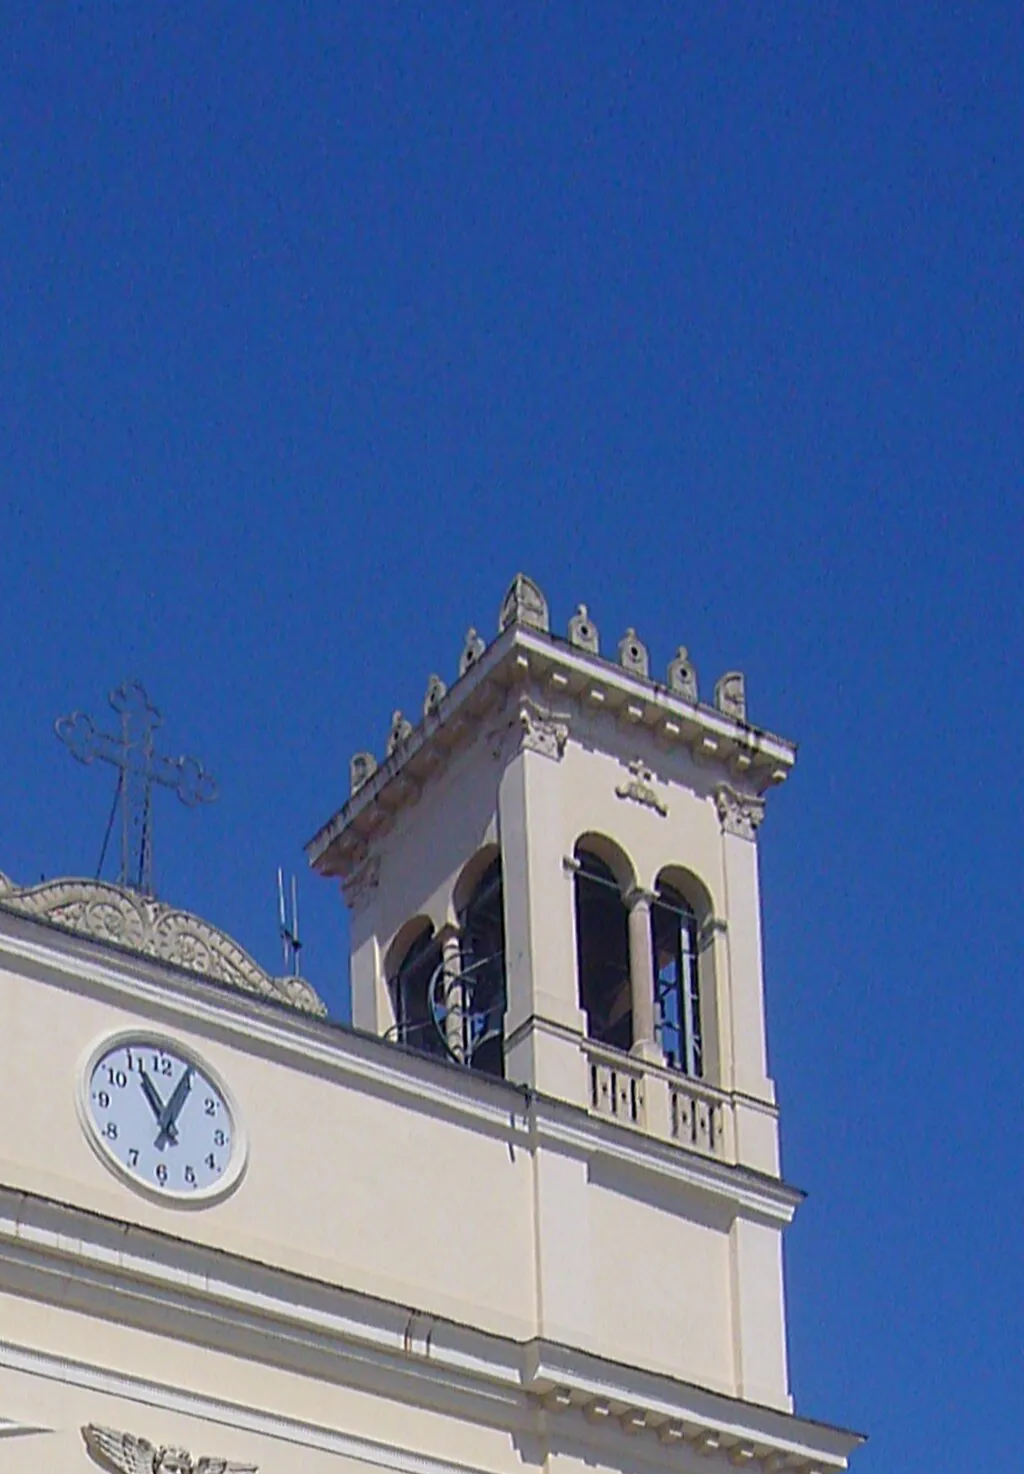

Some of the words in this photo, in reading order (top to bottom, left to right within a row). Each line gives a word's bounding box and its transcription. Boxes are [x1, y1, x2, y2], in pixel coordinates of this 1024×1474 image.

[127, 1055, 145, 1073] 11
[152, 1055, 172, 1077] 12
[107, 1068, 127, 1088] 10
[98, 1091, 110, 1108] 9
[205, 1099, 216, 1117] 2
[106, 1122, 118, 1140] 8
[214, 1130, 225, 1146] 3
[128, 1149, 140, 1167] 7
[204, 1152, 215, 1170] 4
[156, 1164, 168, 1181] 6
[184, 1166, 196, 1184] 5
